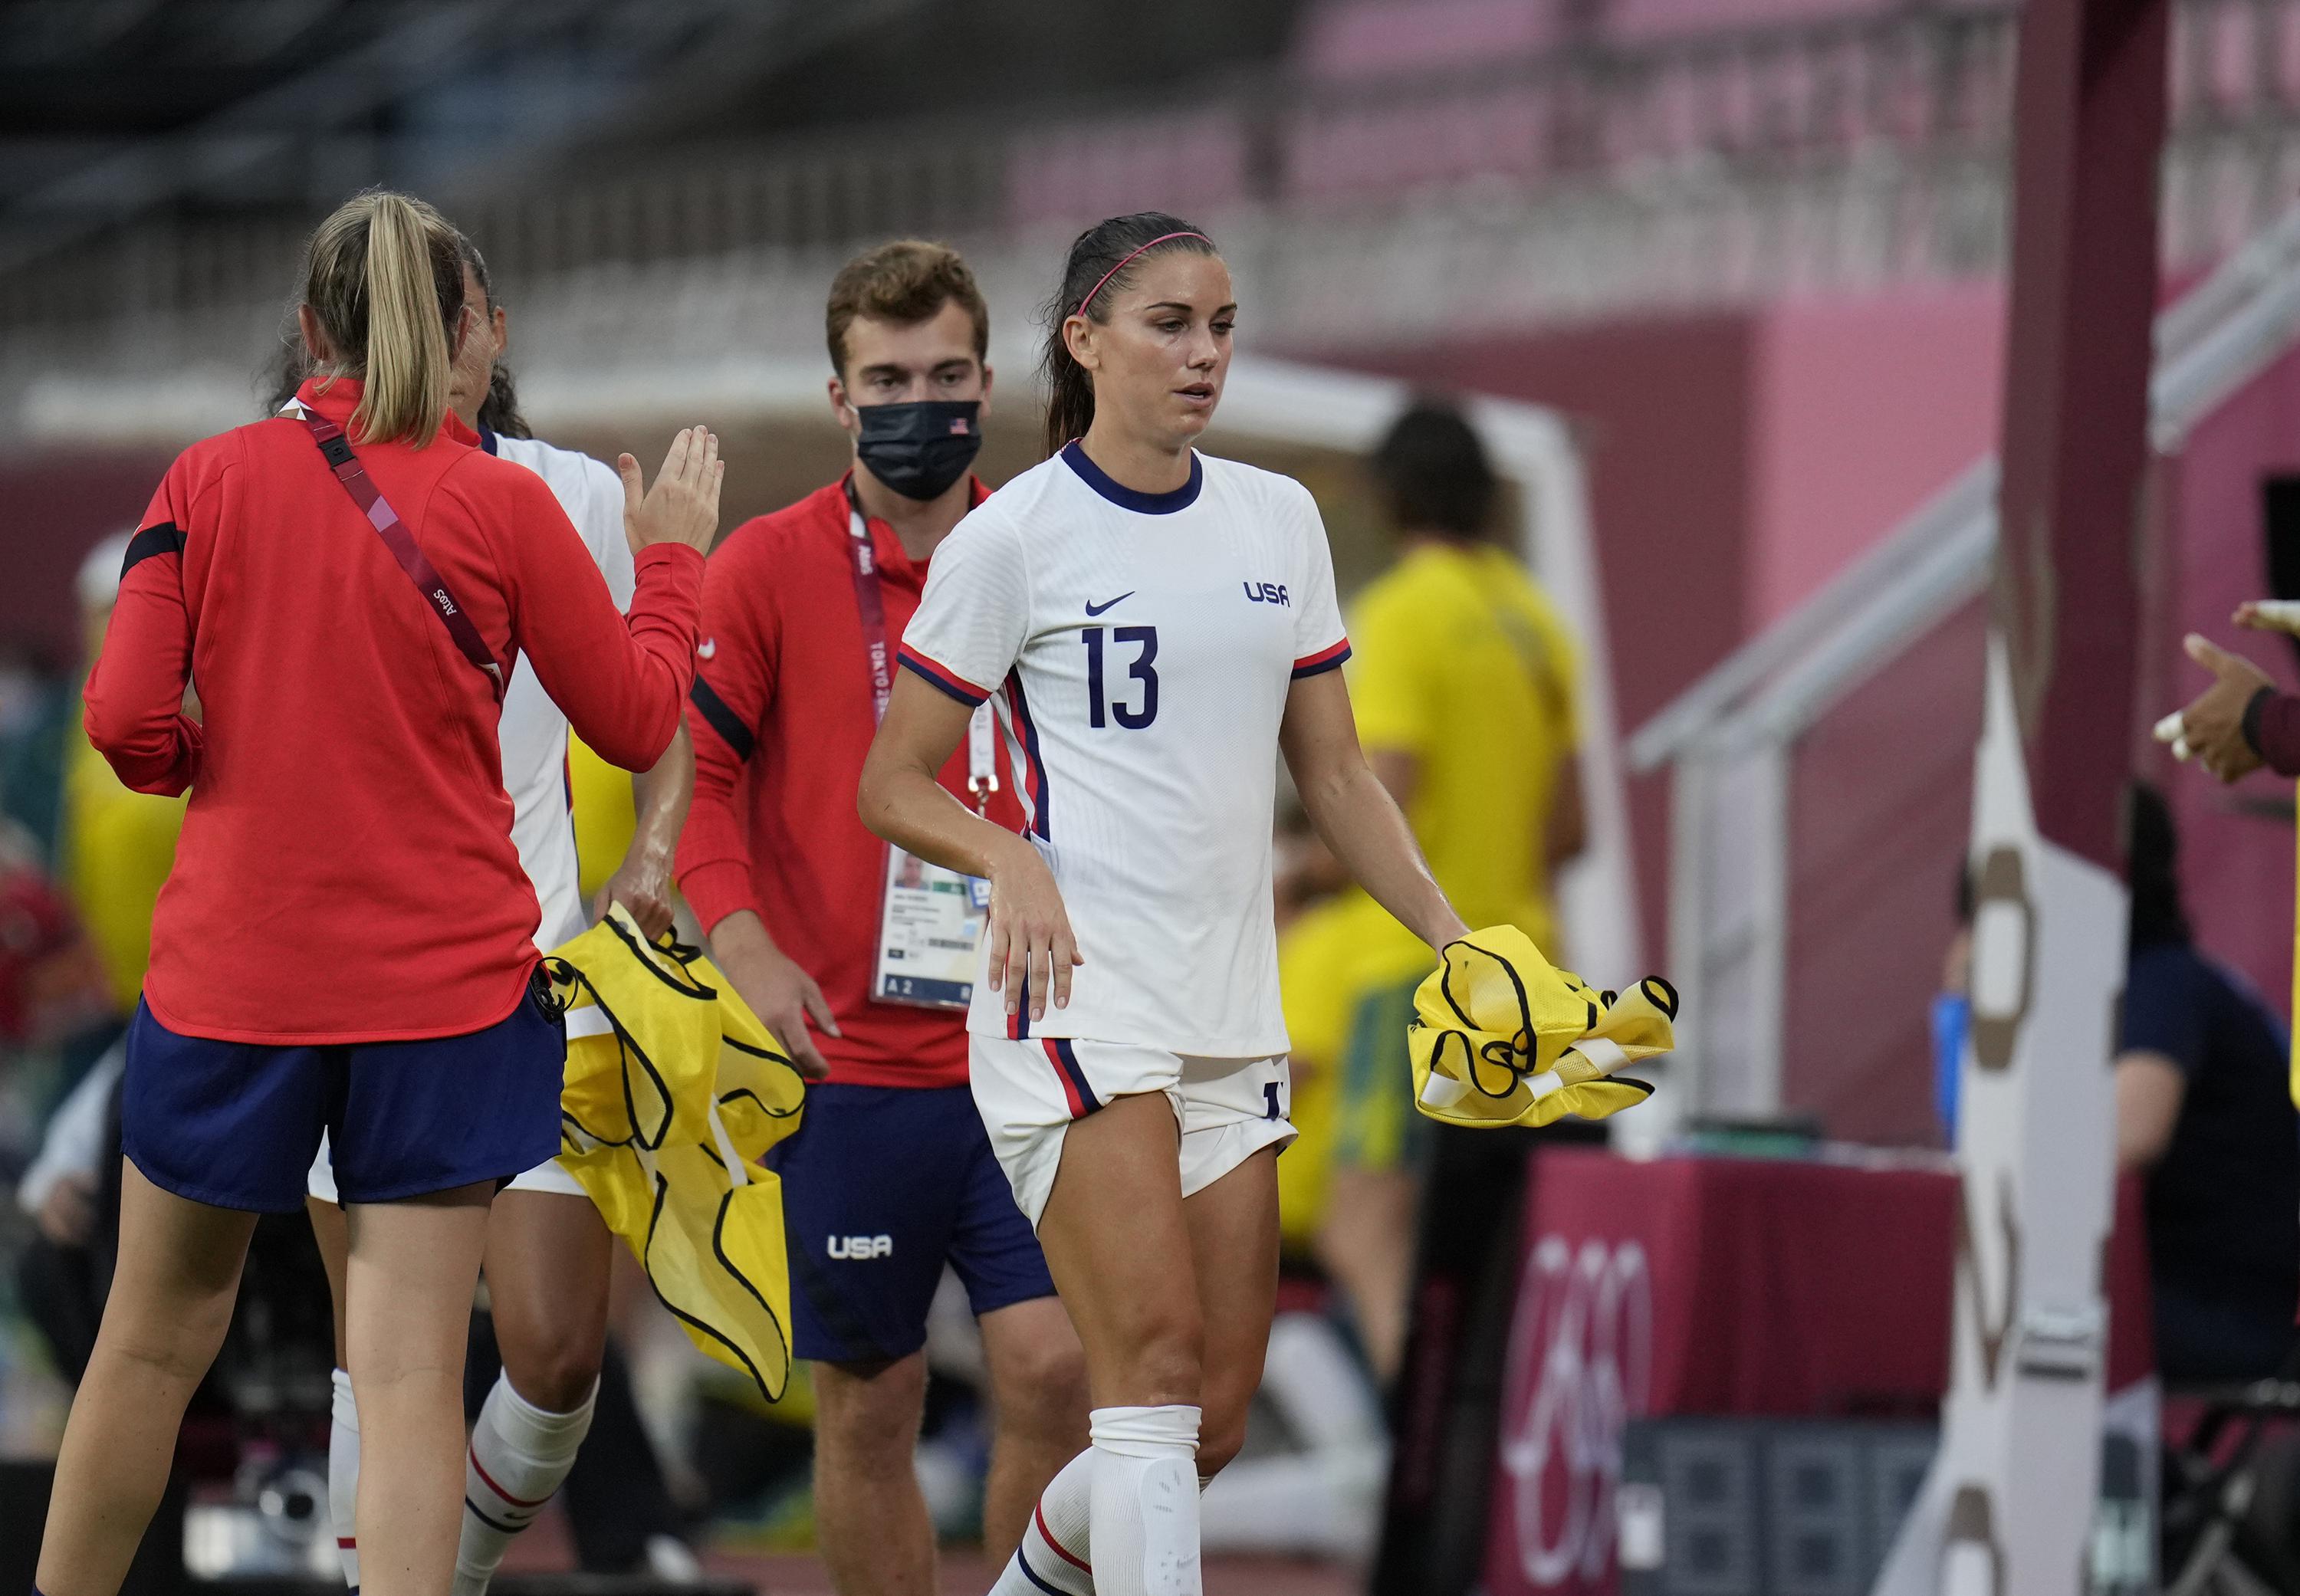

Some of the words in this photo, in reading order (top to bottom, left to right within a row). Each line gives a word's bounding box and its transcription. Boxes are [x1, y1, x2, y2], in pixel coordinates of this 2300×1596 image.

[432, 589, 457, 616] Atos
[1243, 581, 1290, 608] USA
[870, 641, 889, 688] TOKYO
[1082, 626, 1159, 730] 13
[827, 1234, 892, 1259] USA
